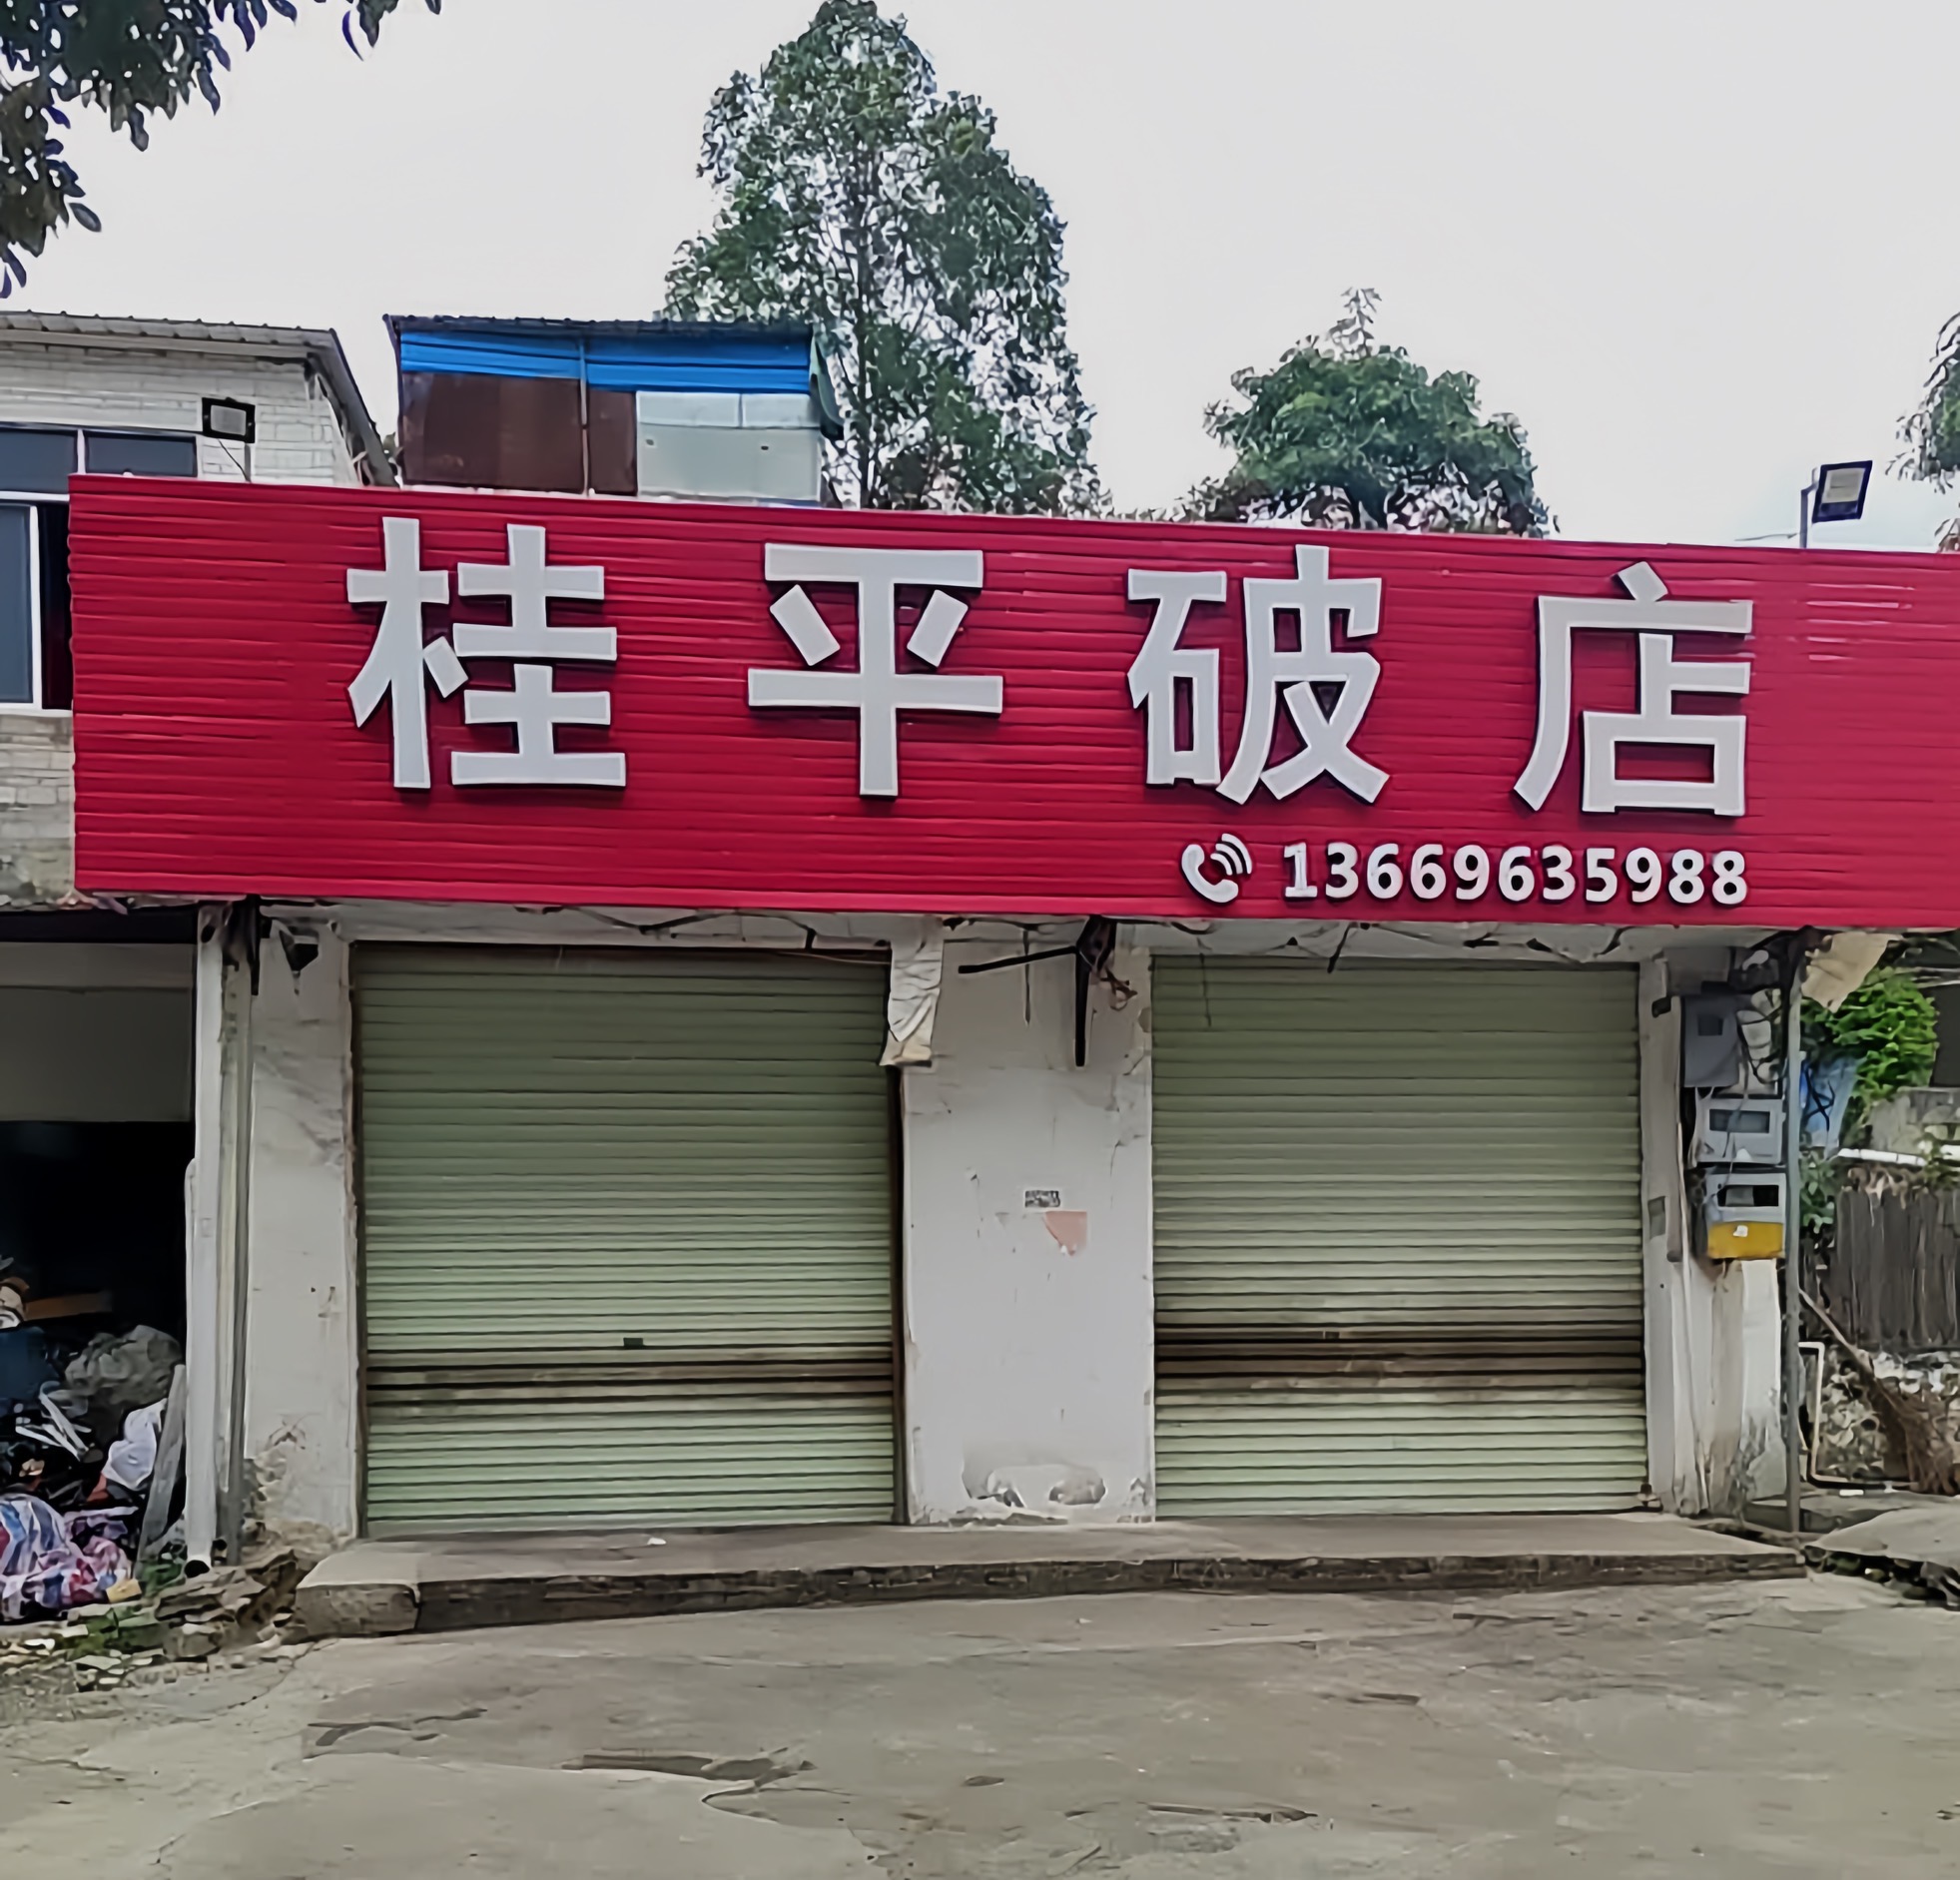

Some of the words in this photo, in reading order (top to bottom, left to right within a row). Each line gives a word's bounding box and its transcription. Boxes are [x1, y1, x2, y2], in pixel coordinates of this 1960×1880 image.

[346, 516, 1753, 817] 桂平破店
[1283, 842, 1747, 904] 13669635988
